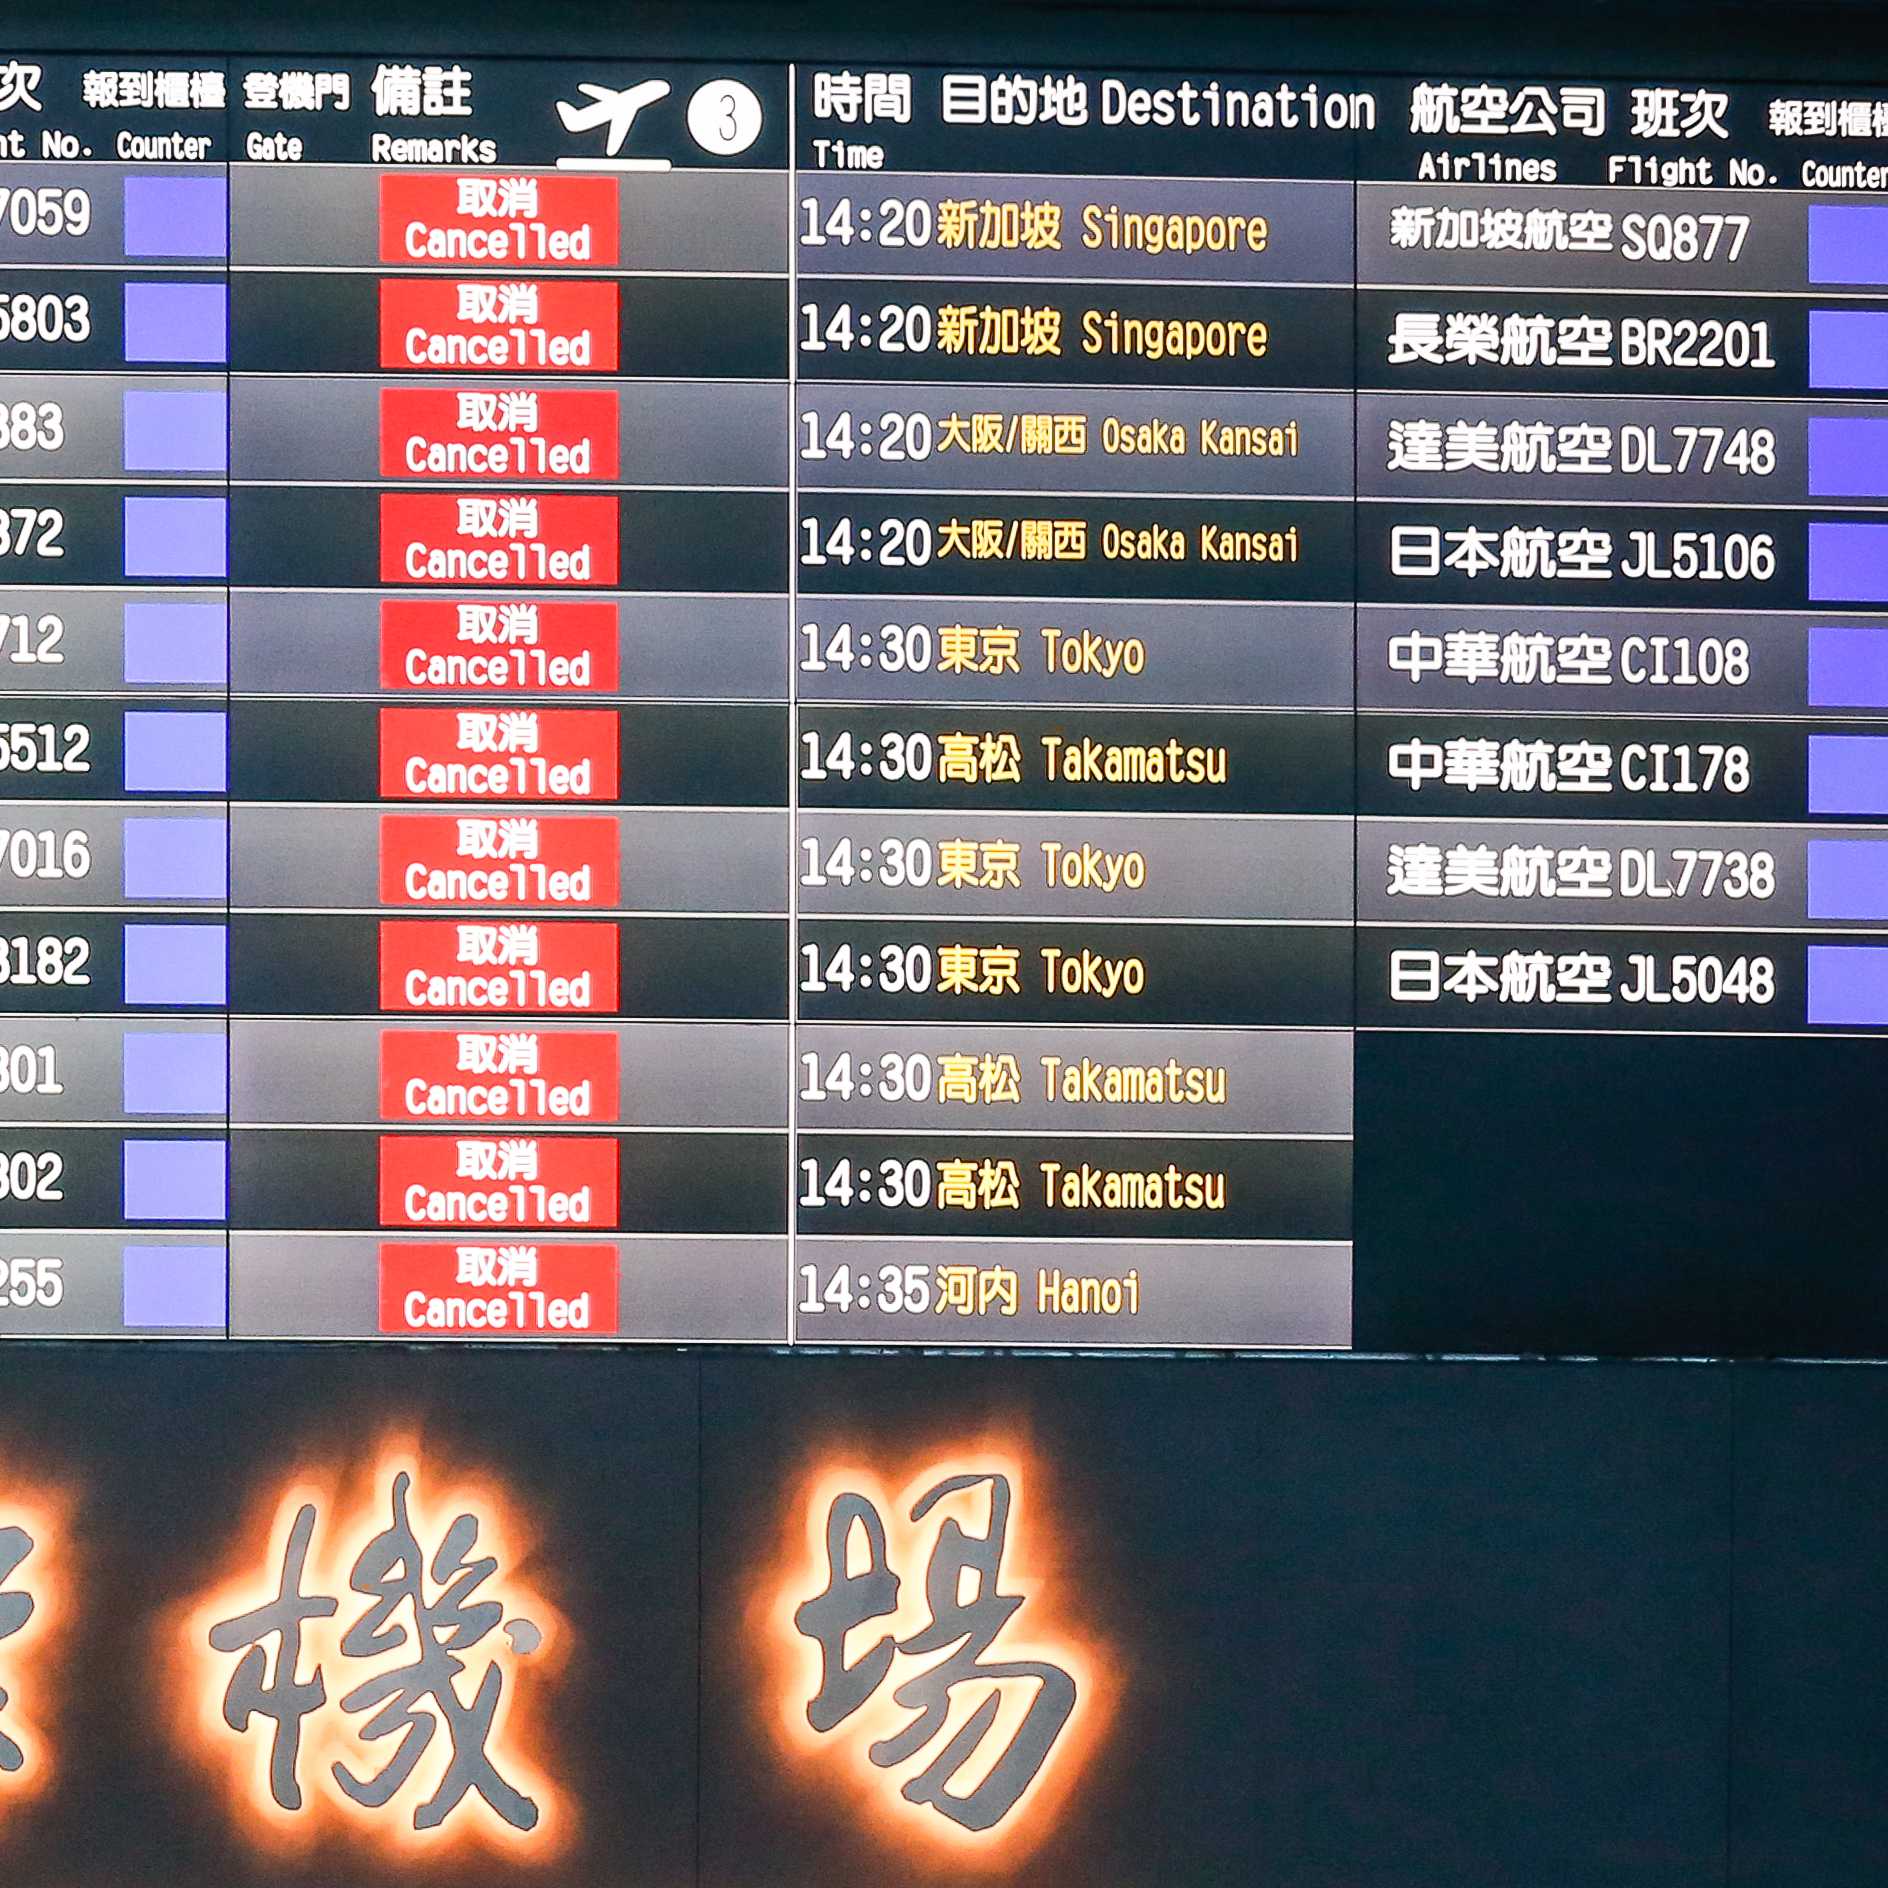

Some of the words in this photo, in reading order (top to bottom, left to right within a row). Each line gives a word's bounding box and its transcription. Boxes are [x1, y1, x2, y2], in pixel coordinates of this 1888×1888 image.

[796, 731, 932, 781] 14:30
[937, 731, 1021, 783] 高松
[1041, 737, 1226, 783] Takamatsu
[1389, 737, 1613, 792] 中華航空
[1621, 744, 1749, 792] CI178
